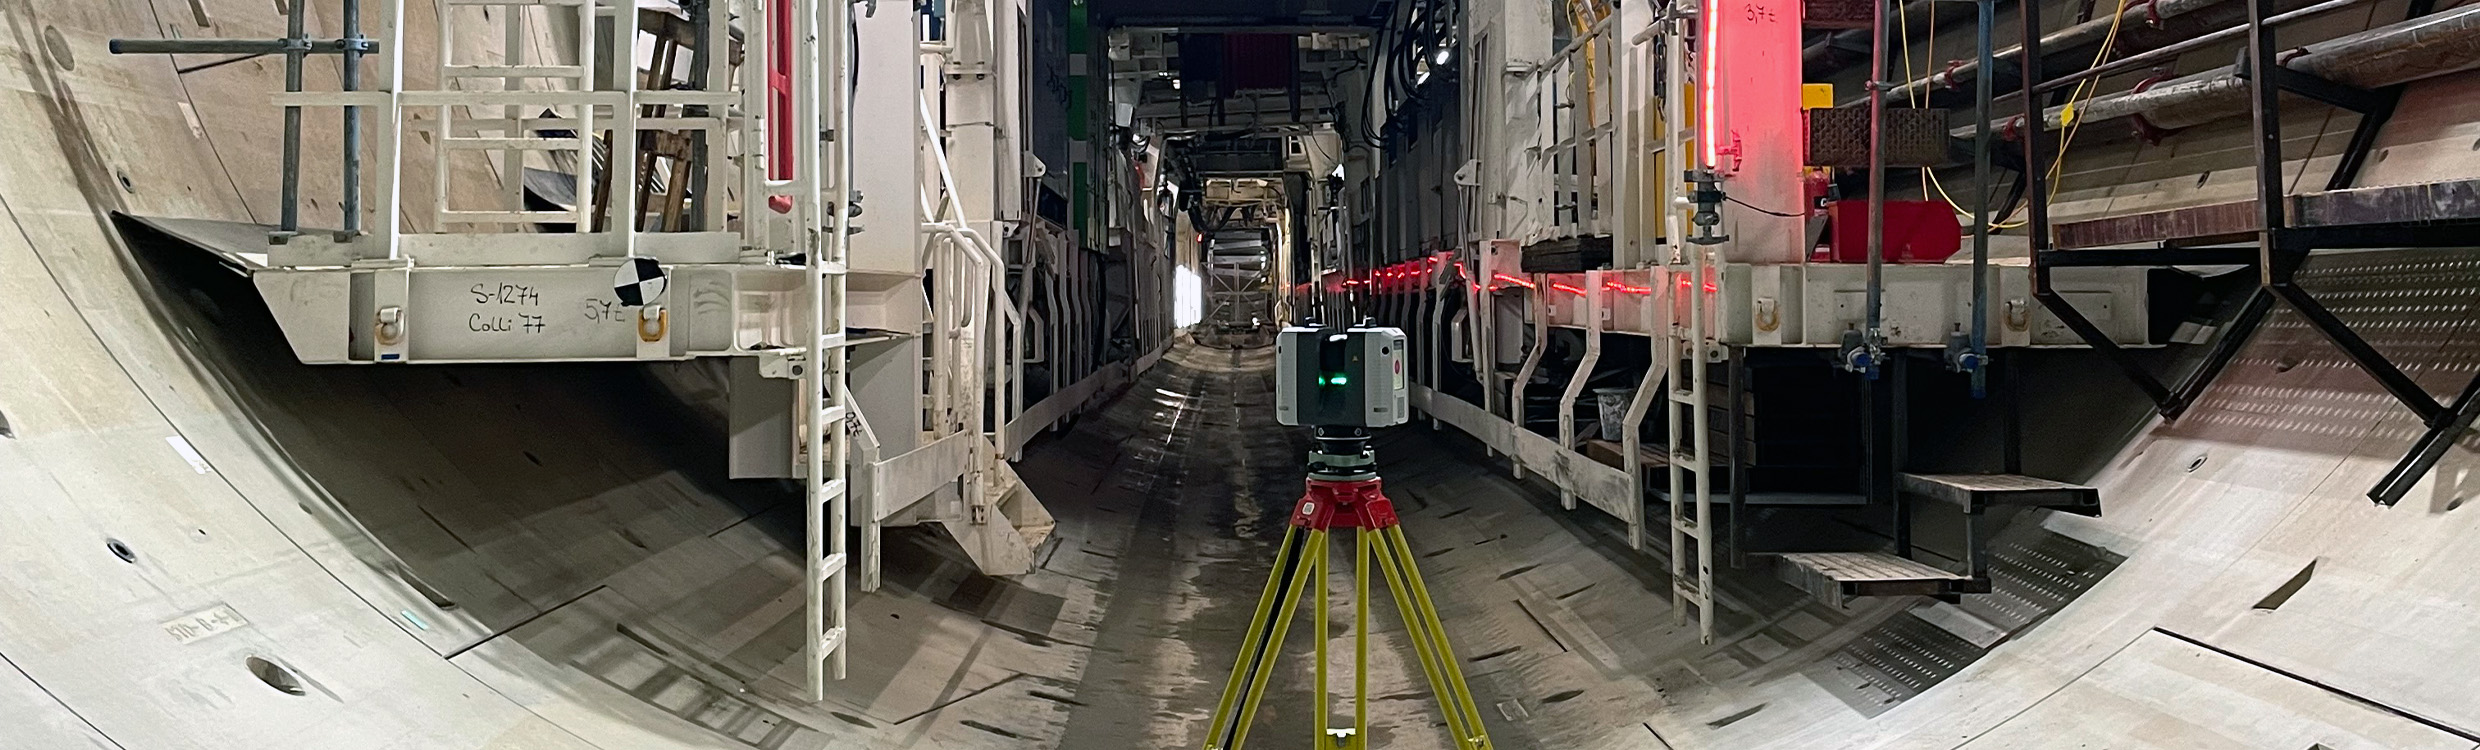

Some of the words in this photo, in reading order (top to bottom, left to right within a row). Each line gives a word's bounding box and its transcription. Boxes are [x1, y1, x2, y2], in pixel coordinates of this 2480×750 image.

[470, 282, 539, 306] S-1274
[468, 313, 512, 333] Colli
[518, 312, 546, 334] 77
